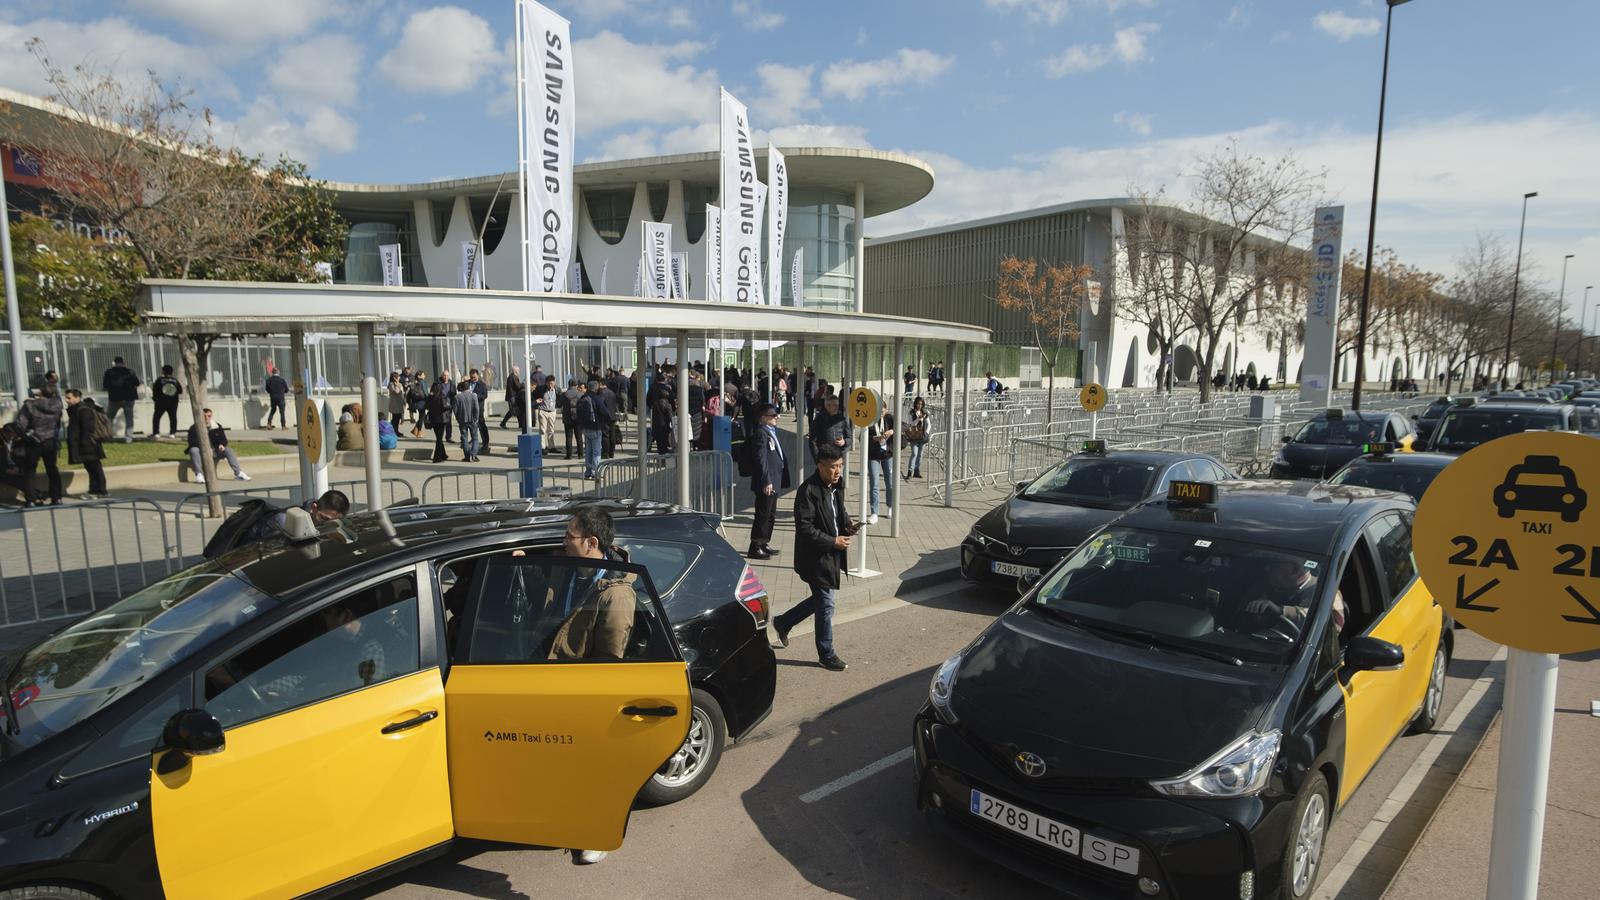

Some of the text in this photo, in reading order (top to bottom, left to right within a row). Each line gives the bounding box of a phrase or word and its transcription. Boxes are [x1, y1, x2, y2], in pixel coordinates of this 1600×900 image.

[544, 30, 563, 194] SAMSUNG
[737, 115, 754, 235] SAMSUNG
[656, 231, 666, 290] SAMSUNG
[855, 409, 861, 417] 3
[1176, 483, 1201, 498] TAXI
[1521, 521, 1552, 534] TAXI
[1117, 548, 1145, 560] LIBRE
[1448, 535, 1519, 571] 2A
[996, 563, 1018, 576] 7382
[496, 732, 573, 745] AMB Taxi 6913
[84, 805, 130, 825] HYBRID
[983, 798, 1073, 848] 2789 LRG
[1091, 840, 1130, 866] SP
